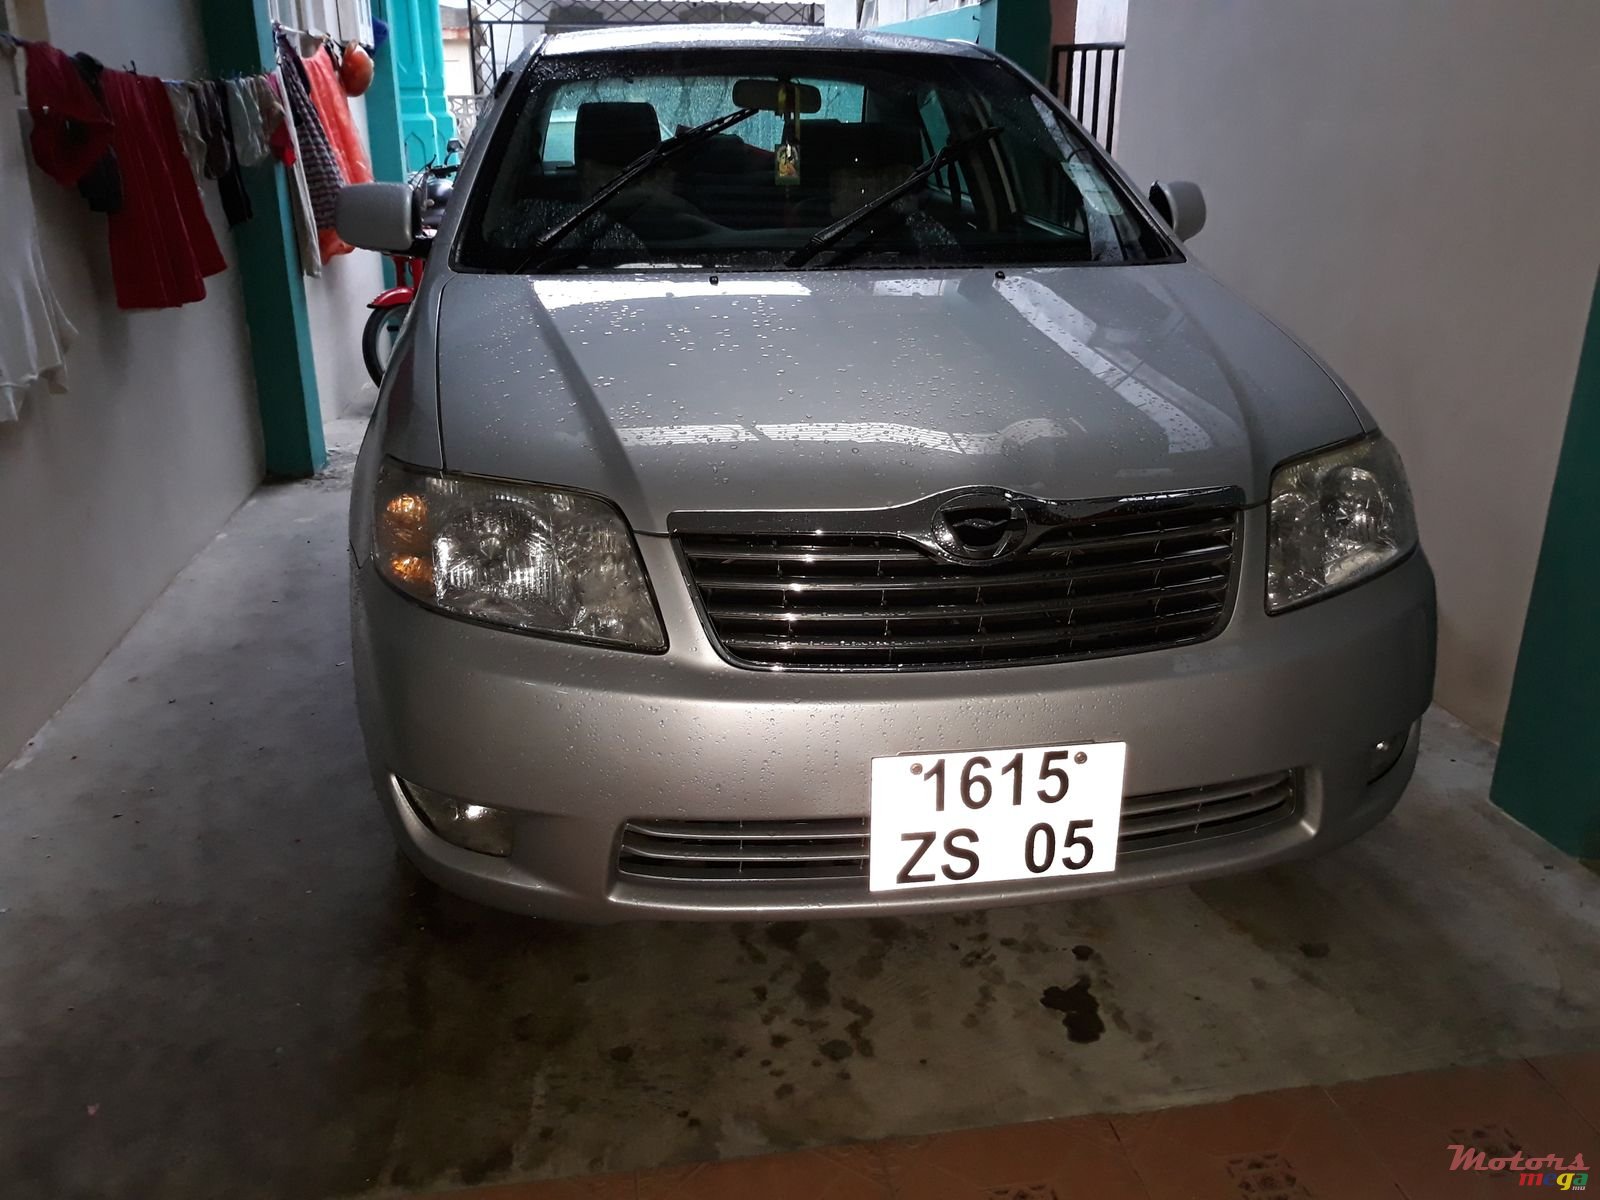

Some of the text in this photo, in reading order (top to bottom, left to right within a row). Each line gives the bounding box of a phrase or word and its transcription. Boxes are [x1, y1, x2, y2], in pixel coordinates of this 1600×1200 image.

[923, 750, 1069, 811] 1615
[896, 819, 1094, 884] ZS 05
